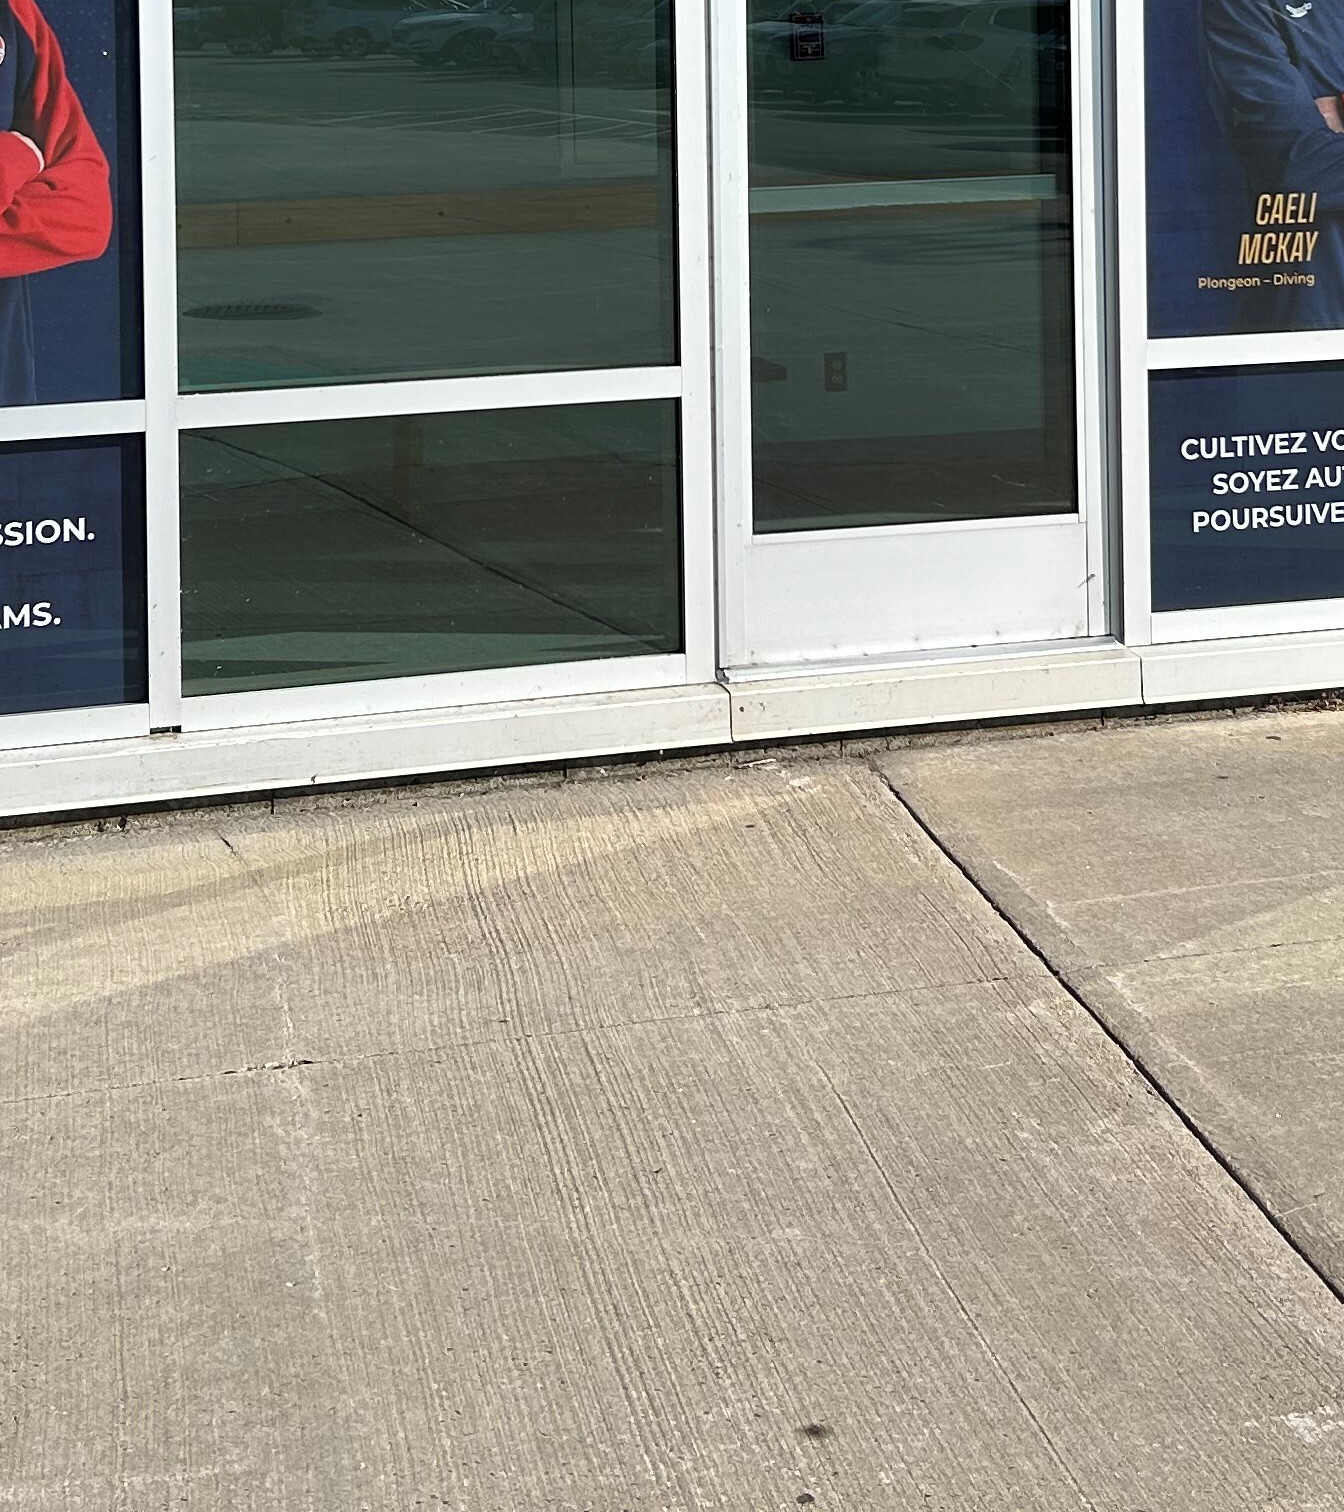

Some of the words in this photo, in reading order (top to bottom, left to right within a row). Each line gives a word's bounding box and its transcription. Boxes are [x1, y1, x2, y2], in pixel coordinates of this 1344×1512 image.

[1256, 192, 1318, 225] CAELI
[1238, 231, 1319, 265] MCKAY
[1198, 274, 1261, 291] Plongeon
[1273, 272, 1315, 289] Diving
[1181, 433, 1306, 461] CULTIVEZ
[1212, 469, 1298, 496] SOYEZ
